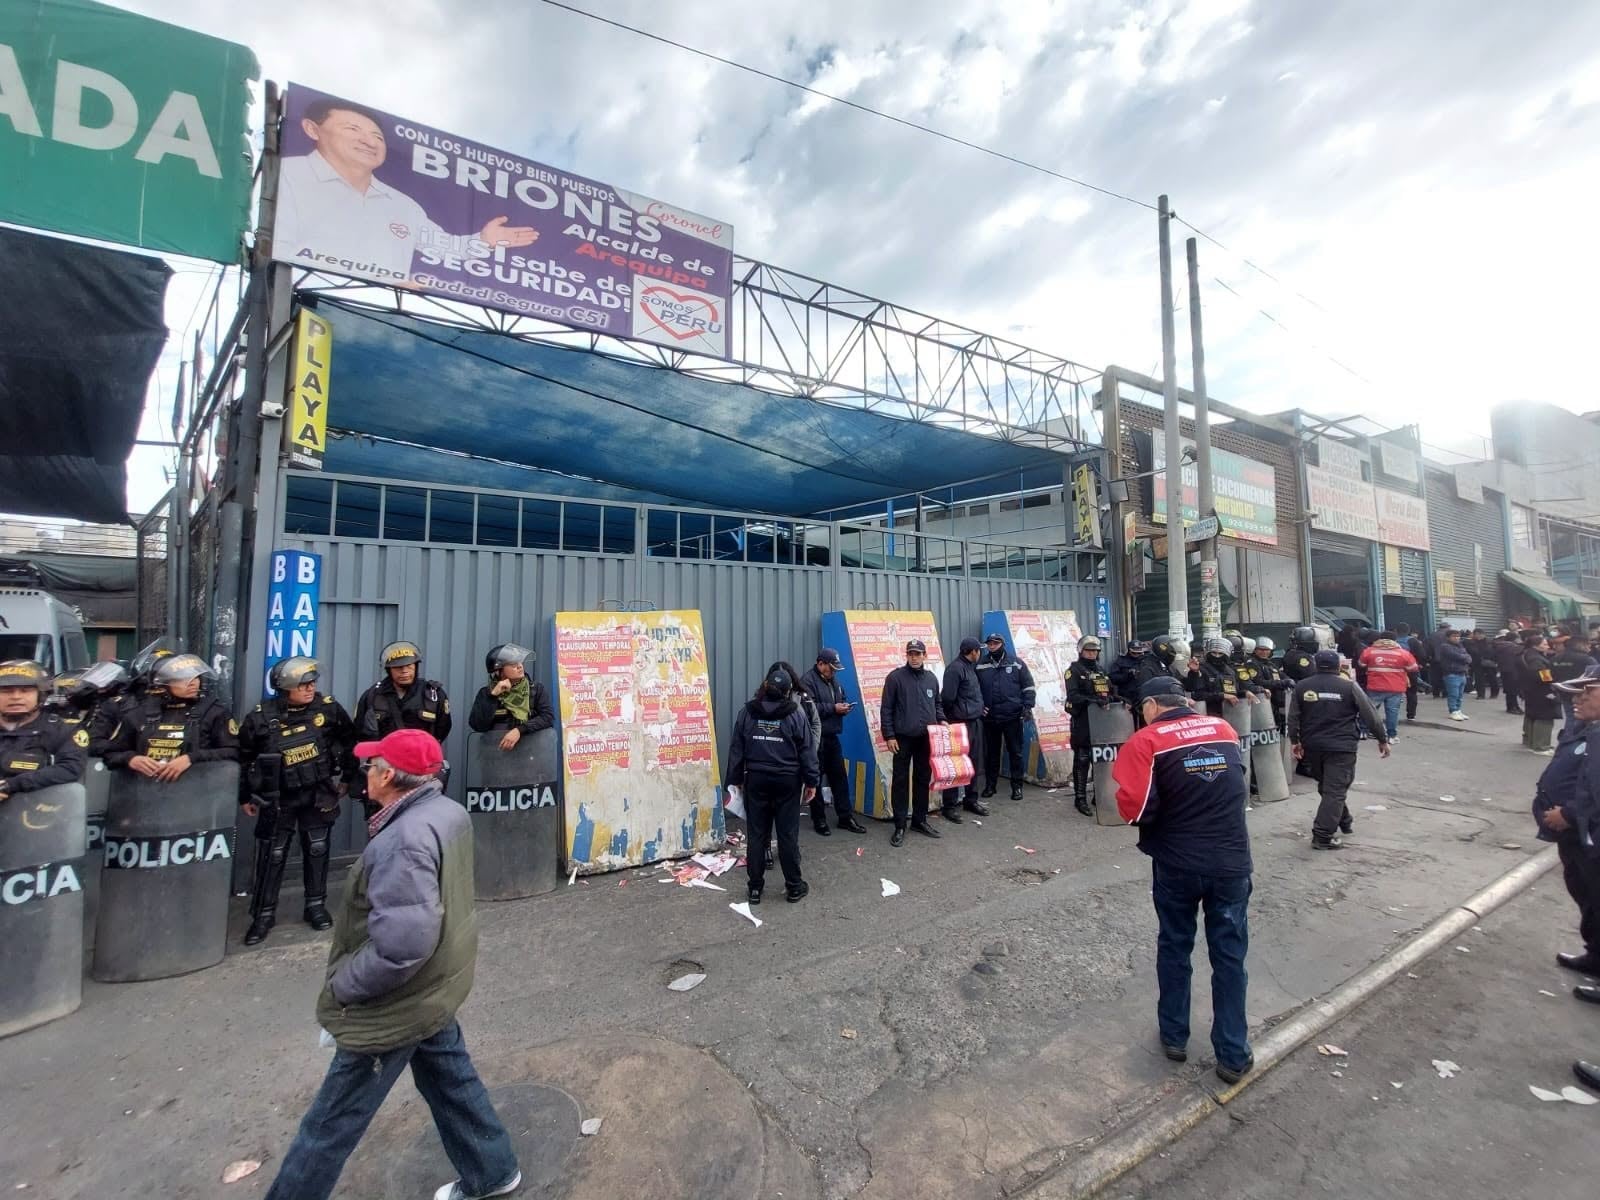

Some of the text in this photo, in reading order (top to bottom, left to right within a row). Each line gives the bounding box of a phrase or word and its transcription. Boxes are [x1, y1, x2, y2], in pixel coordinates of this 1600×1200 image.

[395, 125, 615, 203] CON LOS HUEVOS BIEN PUESTOS
[411, 144, 662, 243] BRIONES
[562, 223, 715, 276] Alcalde de
[645, 202, 722, 240] Coronel
[296, 247, 405, 278] Arequipa
[414, 273, 489, 299] Ciudad
[495, 291, 564, 319] Segura
[419, 246, 631, 312] SEGURIDAD!
[511, 254, 586, 284] sabe
[597, 276, 632, 296] de
[576, 243, 708, 289] Arequipa
[640, 295, 694, 314] SOMOS
[298, 317, 327, 446] PLAYA
[1075, 468, 1093, 541] PLAYA
[600, 639, 631, 650] TEMPORAL
